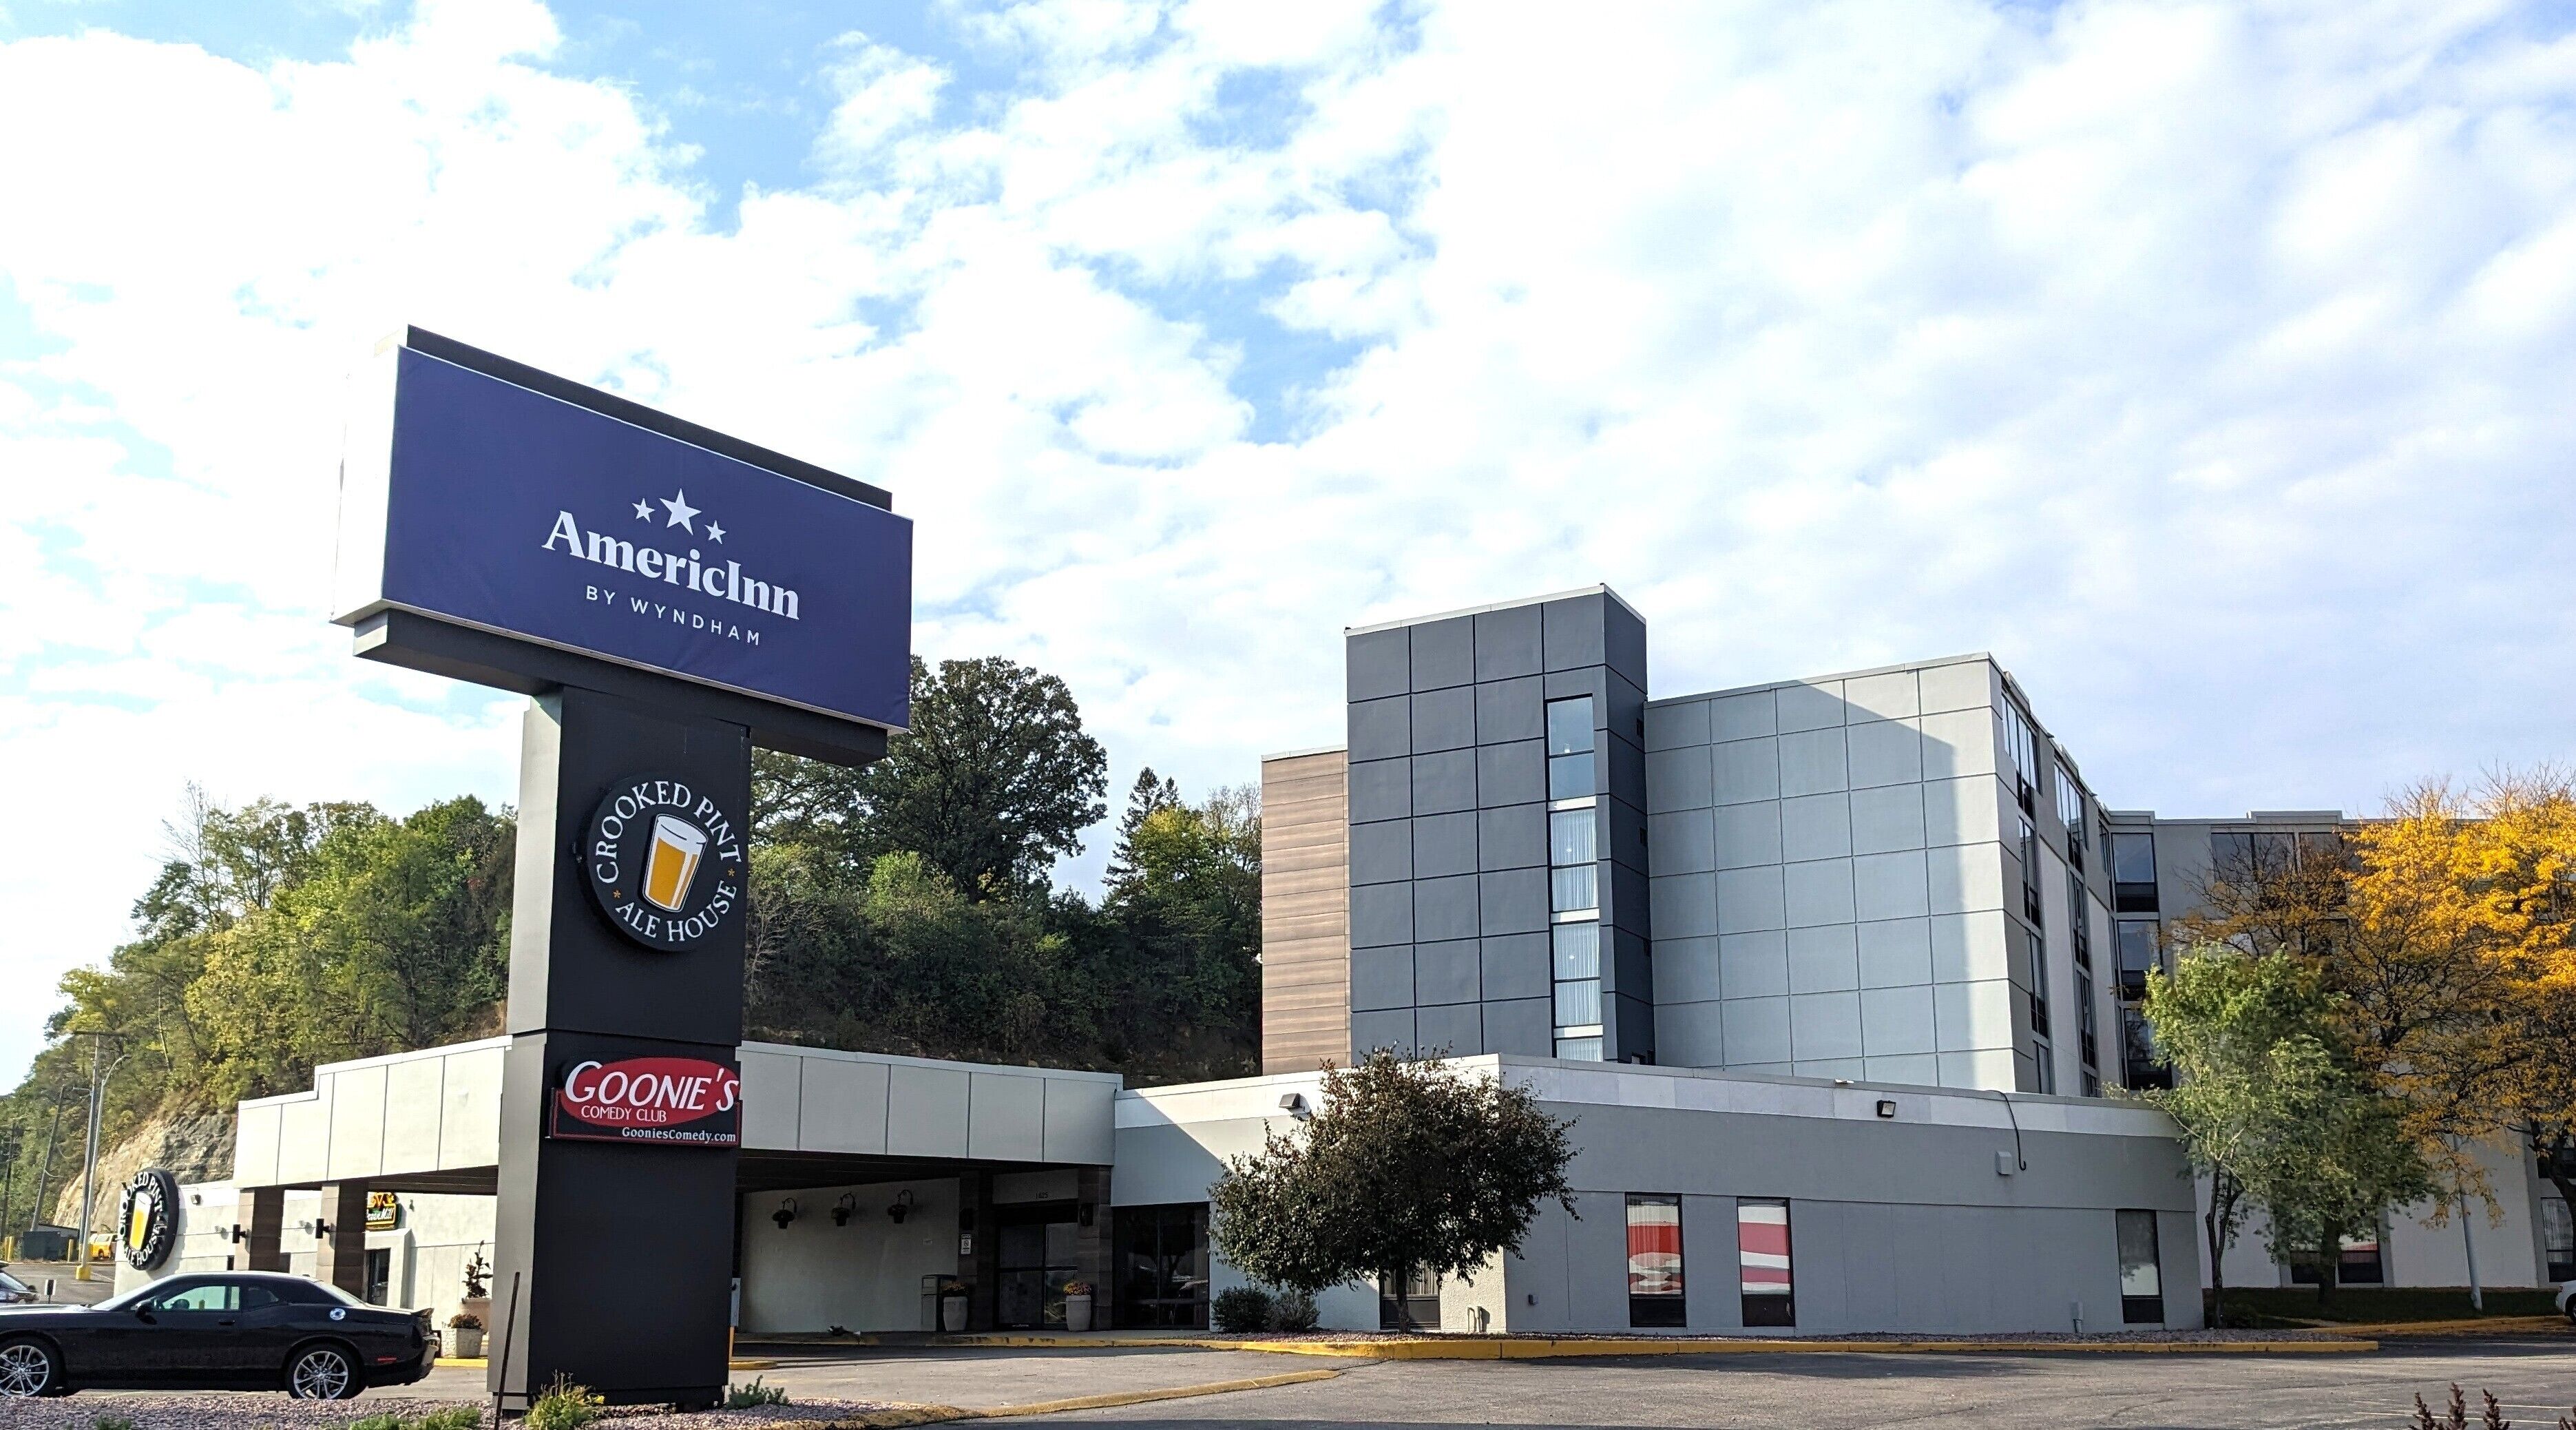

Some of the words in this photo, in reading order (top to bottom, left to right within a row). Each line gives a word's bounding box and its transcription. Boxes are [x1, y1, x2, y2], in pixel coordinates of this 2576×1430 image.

[541, 510, 800, 620] AmericInn
[586, 585, 616, 605] BY
[630, 597, 760, 646] WYNDHAM
[596, 780, 691, 884] CROOKED
[693, 796, 742, 863] PINT
[615, 902, 661, 938] ALE
[667, 880, 737, 942] HOUSE
[580, 1105, 631, 1120] COMEDY
[636, 1108, 667, 1122] CLUB
[622, 1127, 736, 1143] GooniesComedy.com
[148, 1176, 163, 1213] PINT
